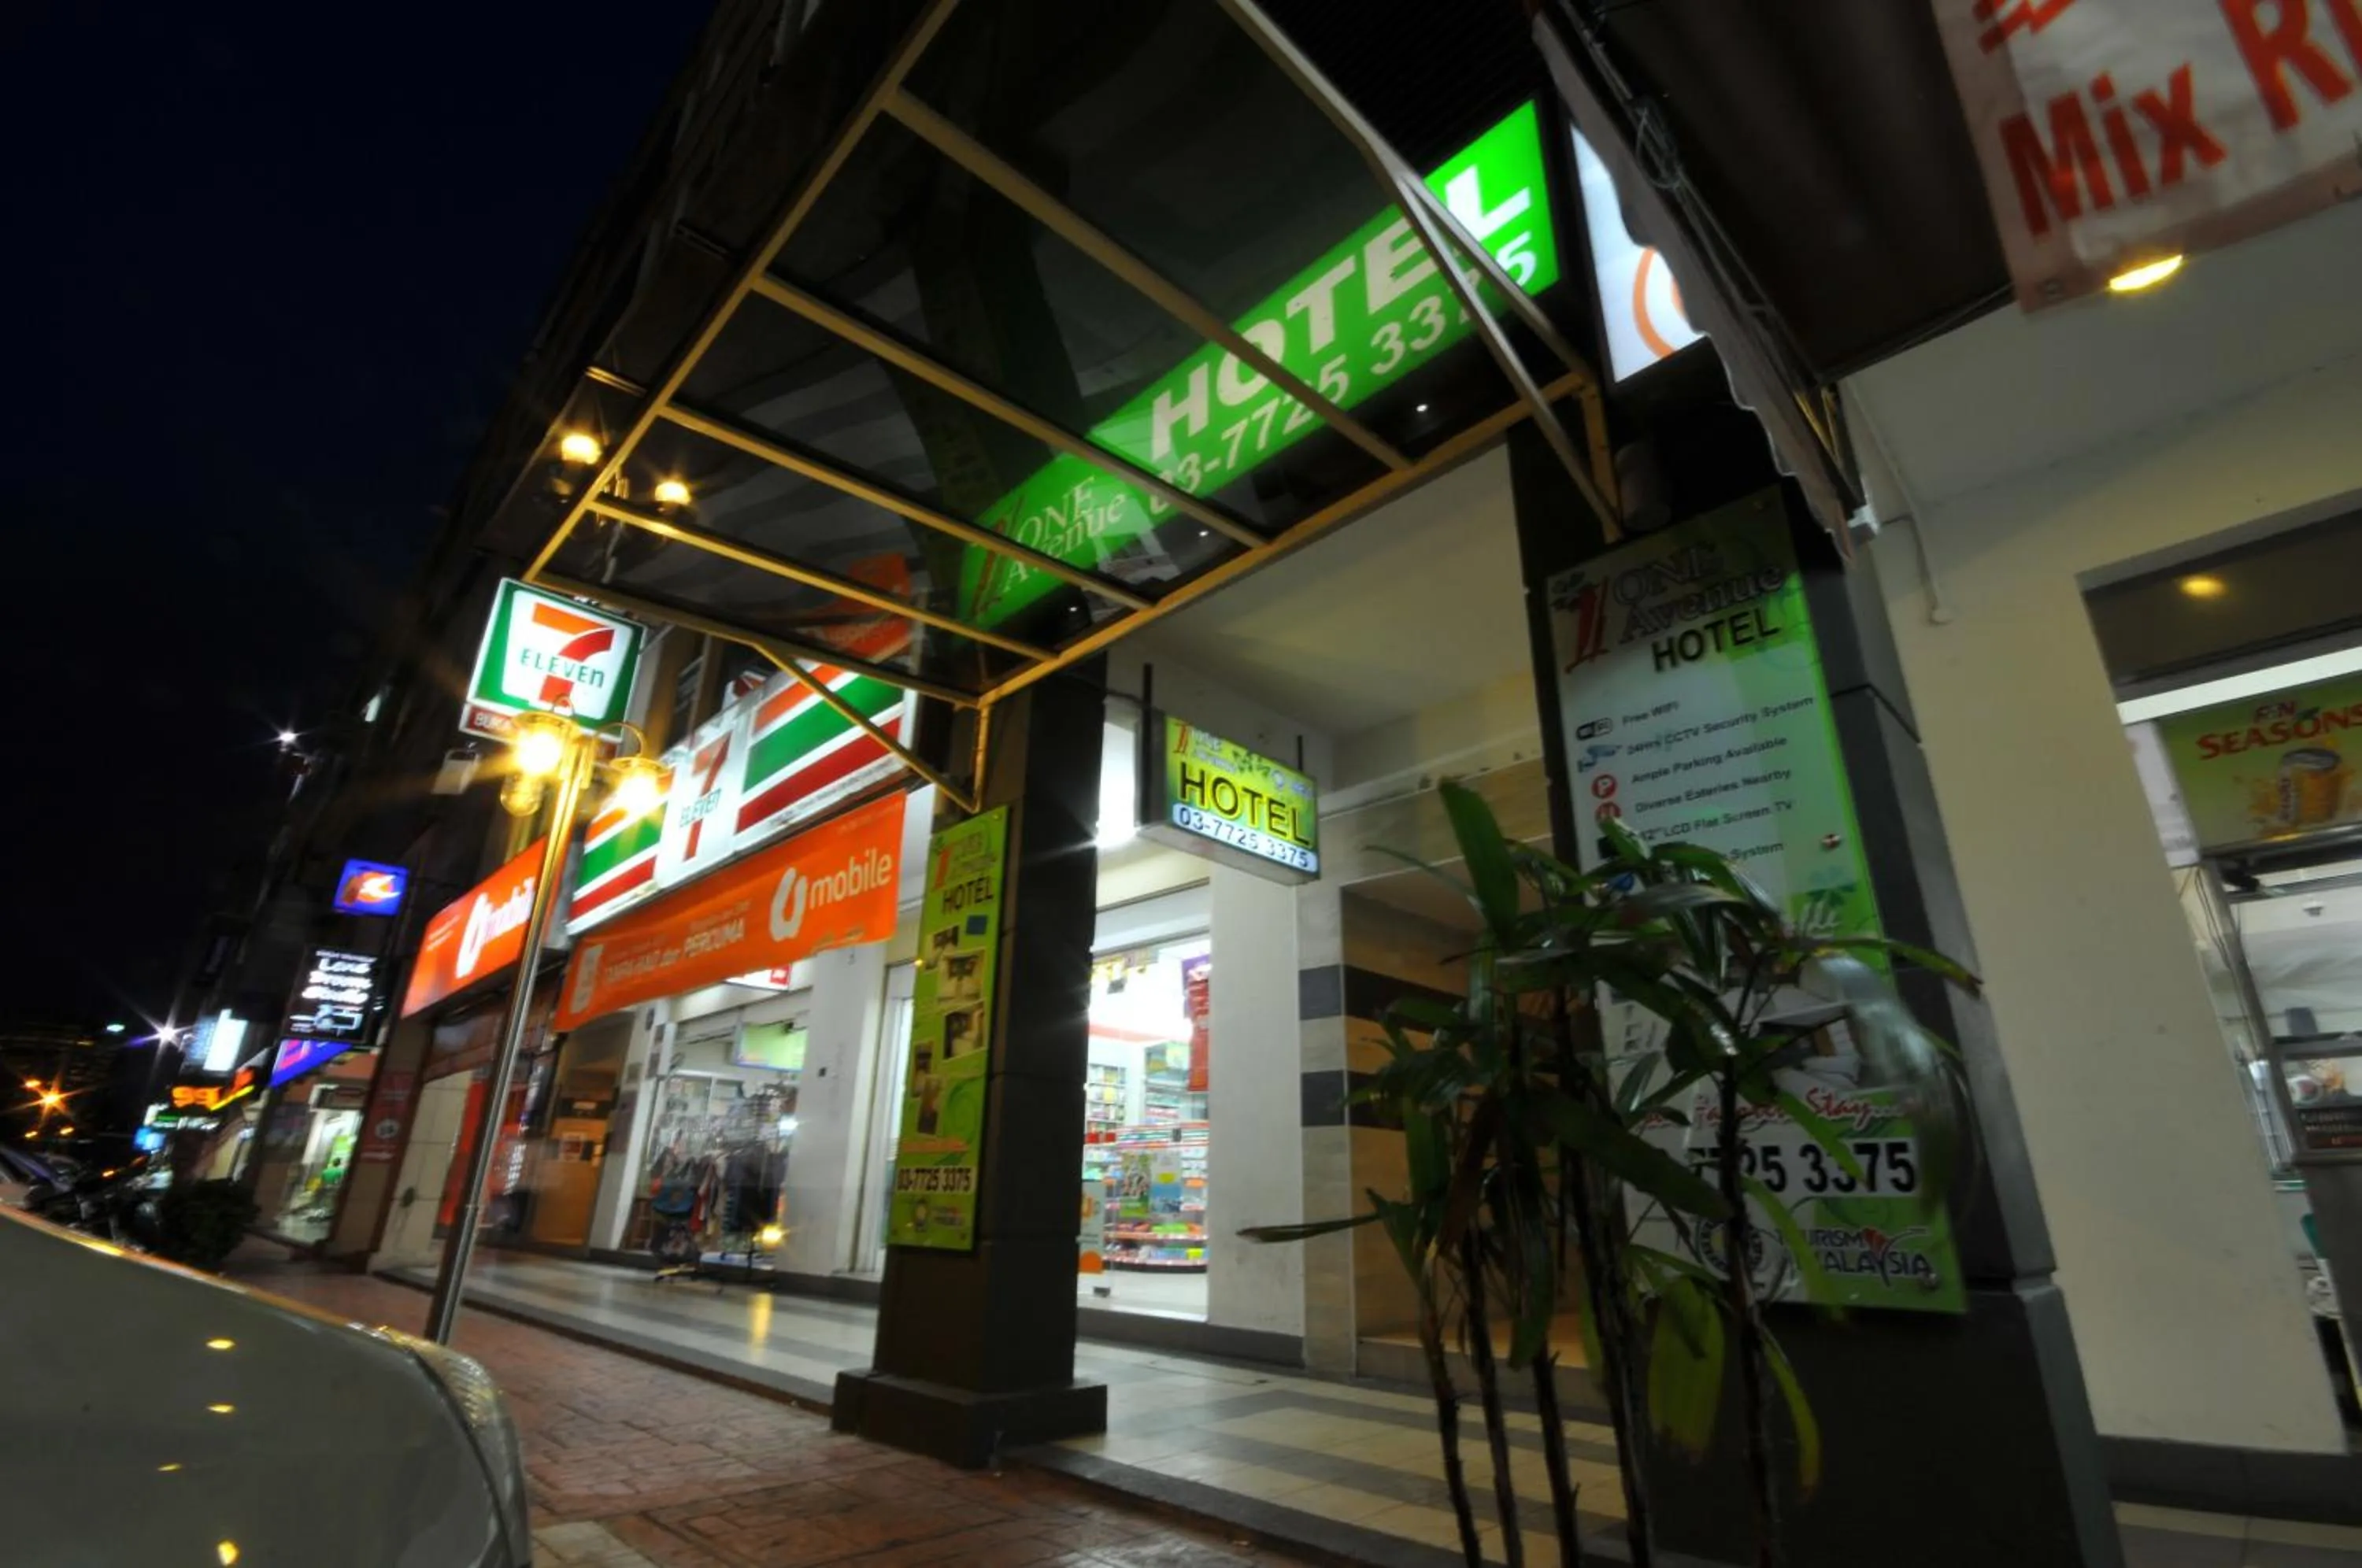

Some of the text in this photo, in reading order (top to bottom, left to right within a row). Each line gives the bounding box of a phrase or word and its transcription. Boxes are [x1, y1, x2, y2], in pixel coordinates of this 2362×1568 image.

[1999, 61, 2228, 241] Mix
[1151, 164, 1531, 461] HOTEL
[1651, 608, 1780, 673] HOTEL
[1664, 727, 1701, 745] CCTV
[1702, 712, 1758, 734] Security
[1760, 697, 1814, 718] System
[1672, 753, 1723, 773] Parking
[1725, 737, 1788, 760] Available
[1180, 760, 1312, 846] HOTEL
[1180, 806, 1309, 868] 03-7725 3375
[809, 846, 892, 911] mobile
[942, 875, 994, 915] HOTEL
[1817, 1248, 1933, 1286] ALAYSIA
